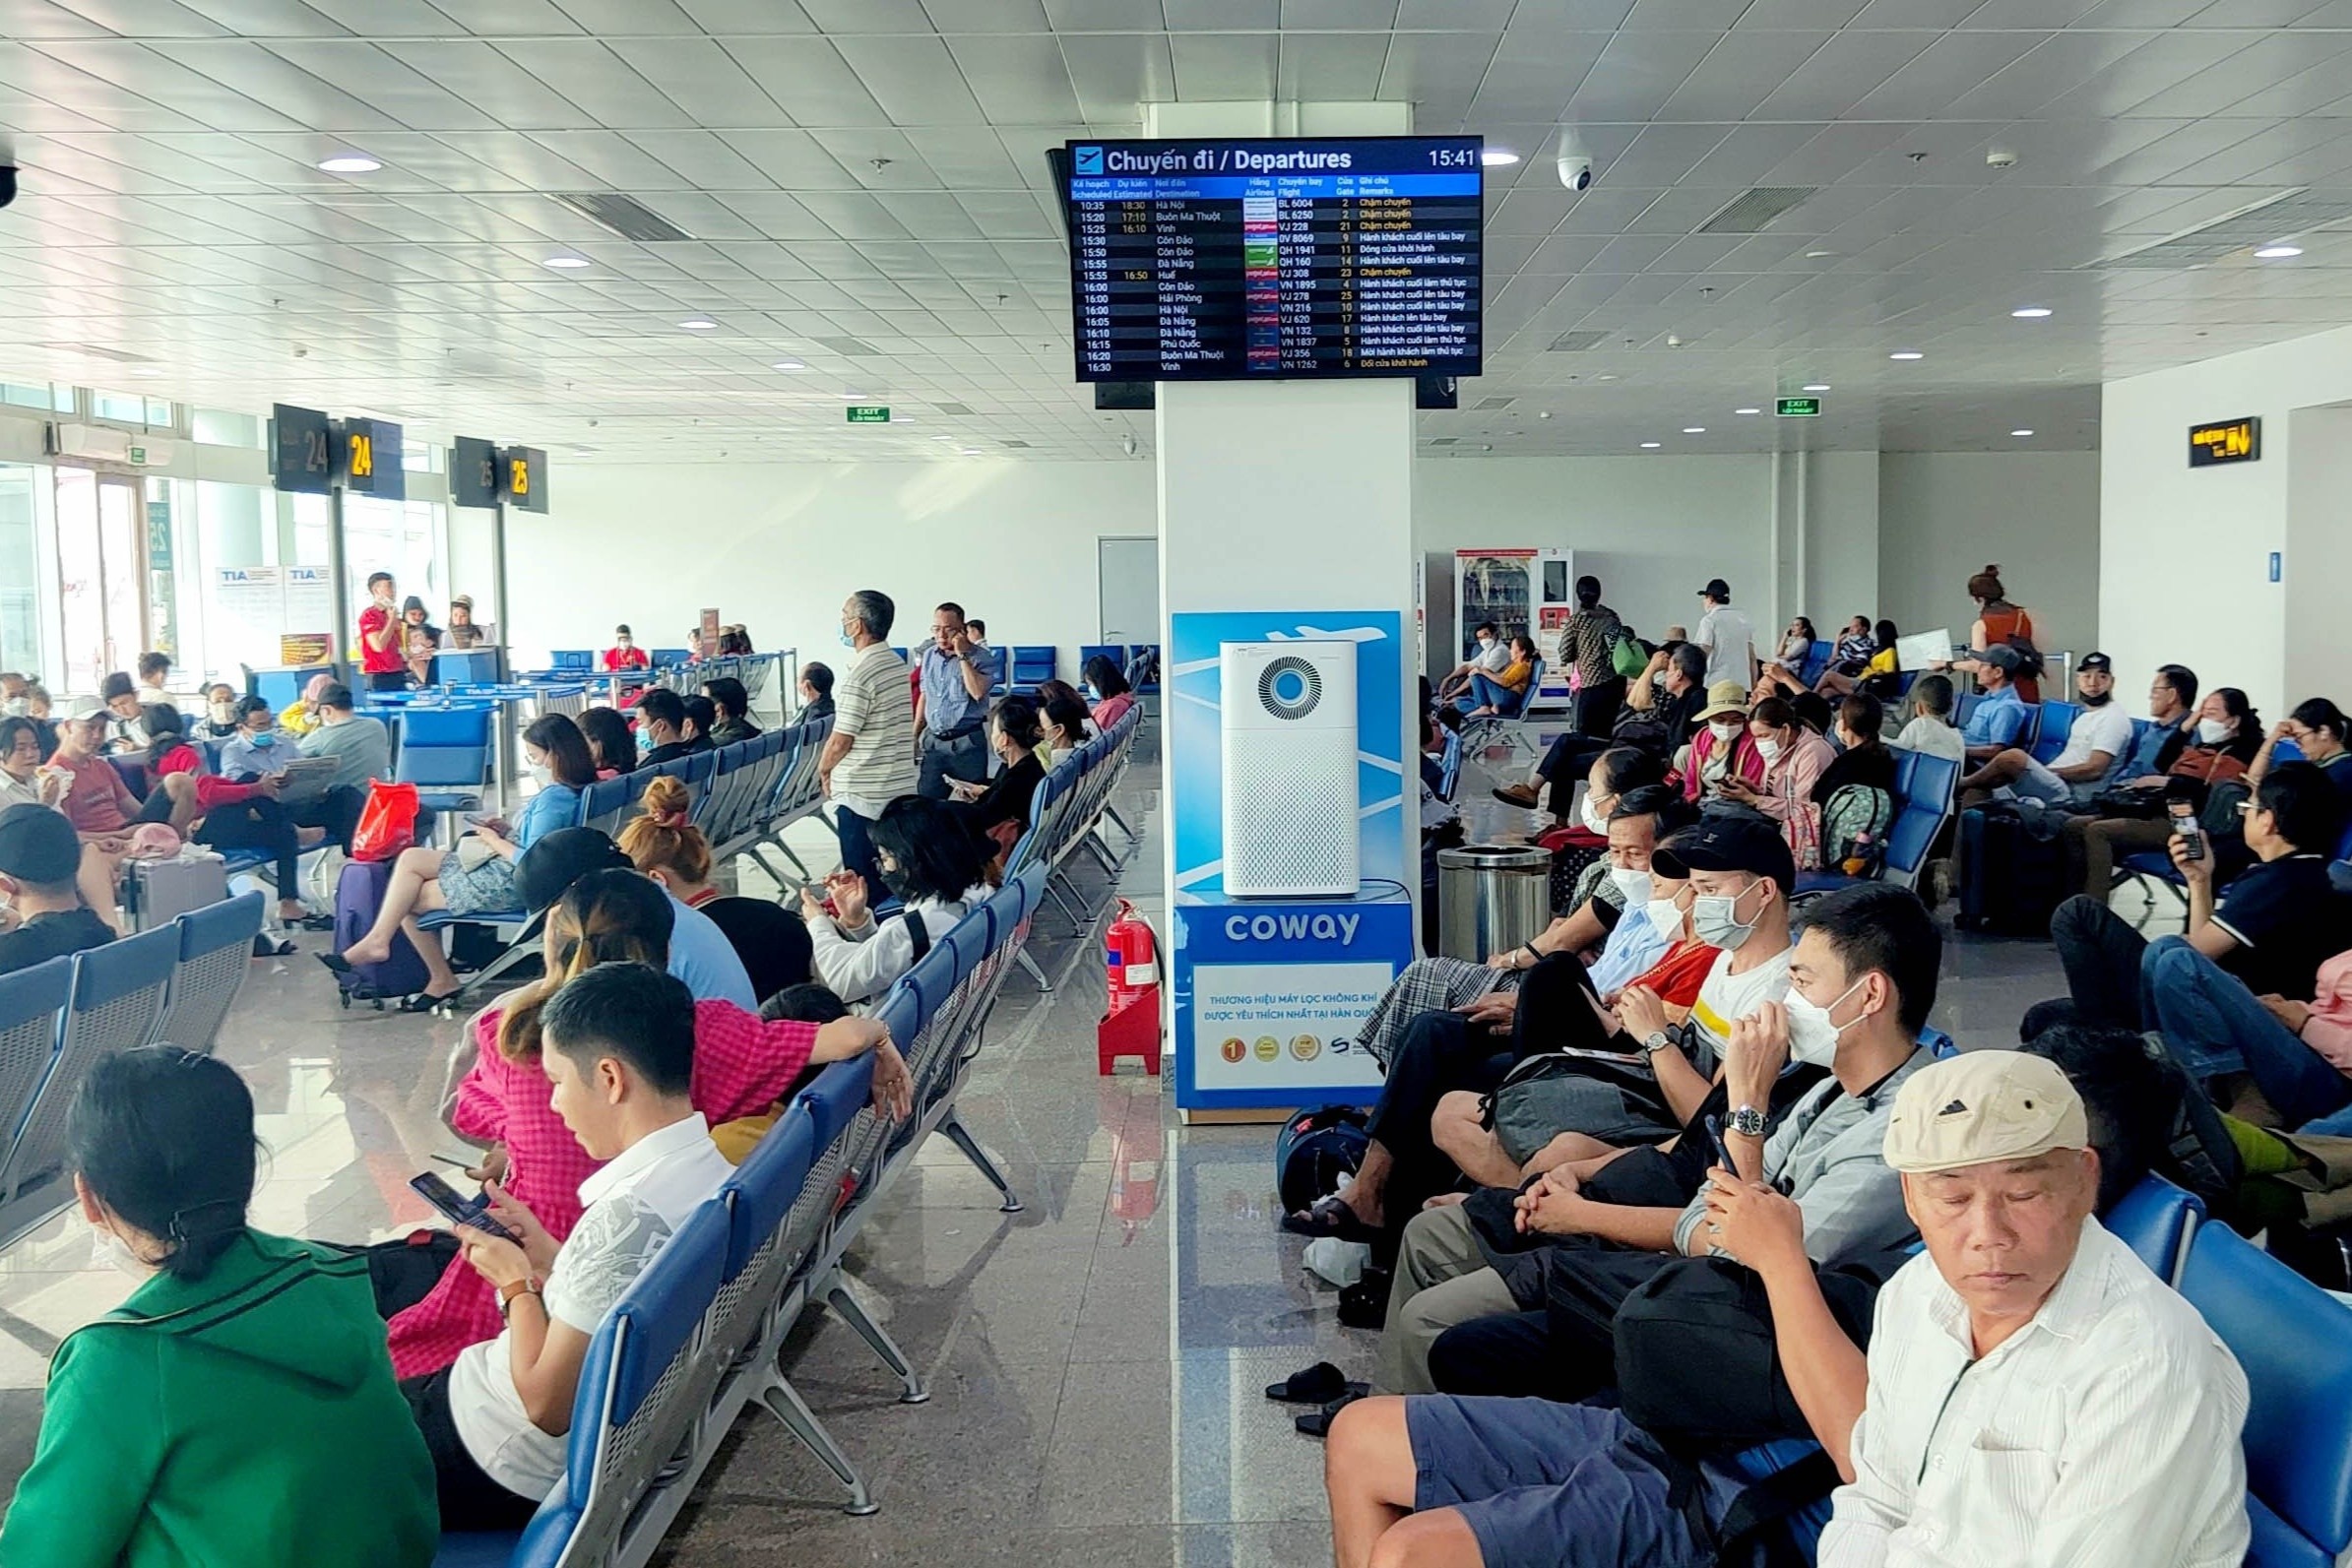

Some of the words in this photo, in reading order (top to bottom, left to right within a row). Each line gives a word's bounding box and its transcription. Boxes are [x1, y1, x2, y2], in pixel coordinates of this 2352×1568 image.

[1108, 149, 1187, 175] Chuyến
[1192, 149, 1214, 170] đi
[1219, 150, 1230, 171] /
[1235, 150, 1352, 174] Departures
[1429, 150, 1474, 166] 15:41
[1278, 199, 1290, 208] BL
[1291, 199, 1313, 208] 6004
[1342, 199, 1349, 208] 2
[1081, 213, 1106, 221] 15:20
[1121, 213, 1146, 221] 17:10
[1278, 211, 1290, 220] BL
[1292, 211, 1313, 220] 6250
[1342, 211, 1349, 220] 2
[1082, 224, 1106, 233] 15:25
[1122, 224, 1147, 233] 16:10
[1278, 222, 1291, 231] VJ
[1292, 222, 1308, 231] 228
[1340, 222, 1351, 231] 21
[1082, 236, 1106, 245] 15:30
[1292, 234, 1314, 243] 8069
[1343, 233, 1349, 242] 9
[1082, 248, 1107, 257] 15:50
[1279, 246, 1293, 255] QH
[1341, 245, 1351, 254] 11
[1083, 260, 1108, 269] 15:55
[1279, 258, 1293, 267] QH
[1341, 257, 1352, 266] 14
[1083, 272, 1108, 281] 15:55
[1124, 271, 1148, 280] 16:50
[1293, 269, 1309, 278] 308
[1084, 282, 1108, 291] 16:00
[1280, 281, 1293, 289] VN
[1296, 281, 1316, 289] 1895
[1085, 294, 1109, 303] 16:00
[1280, 292, 1292, 301] VJ
[1293, 292, 1309, 301] 278
[1341, 291, 1353, 300] 25
[1085, 306, 1110, 315] 16:00
[1295, 303, 1311, 312] 216
[1280, 315, 1293, 324] VJ
[1294, 315, 1310, 324] 620
[1342, 314, 1353, 323] 17
[1086, 329, 1110, 338] 16:10
[1281, 338, 1294, 346] VN
[1296, 338, 1317, 346] 1837
[1294, 348, 1310, 357] 356
[1297, 360, 1317, 369] 1262
[305, 430, 329, 473] 24
[350, 433, 373, 477] 24
[512, 458, 529, 495] 25
[222, 571, 249, 581] TIA
[289, 569, 316, 580] TIA
[1210, 995, 1252, 1005] THƯƠNG
[1254, 993, 1276, 1006] HIỆU
[1279, 992, 1300, 1004] MÁY
[1301, 994, 1321, 1006] LỌC
[1322, 991, 1360, 1003] KHÔNG
[1361, 991, 1378, 1002] KHÍ
[1204, 1010, 1234, 1022] ĐƯỢC
[1236, 1008, 1253, 1020] YÊU
[1256, 1008, 1284, 1020] THÍCH
[1286, 1007, 1311, 1019] NHẤT
[1313, 1009, 1328, 1021] TẠI
[1330, 1008, 1351, 1019] HÀN
[1227, 1040, 1238, 1059] 1
